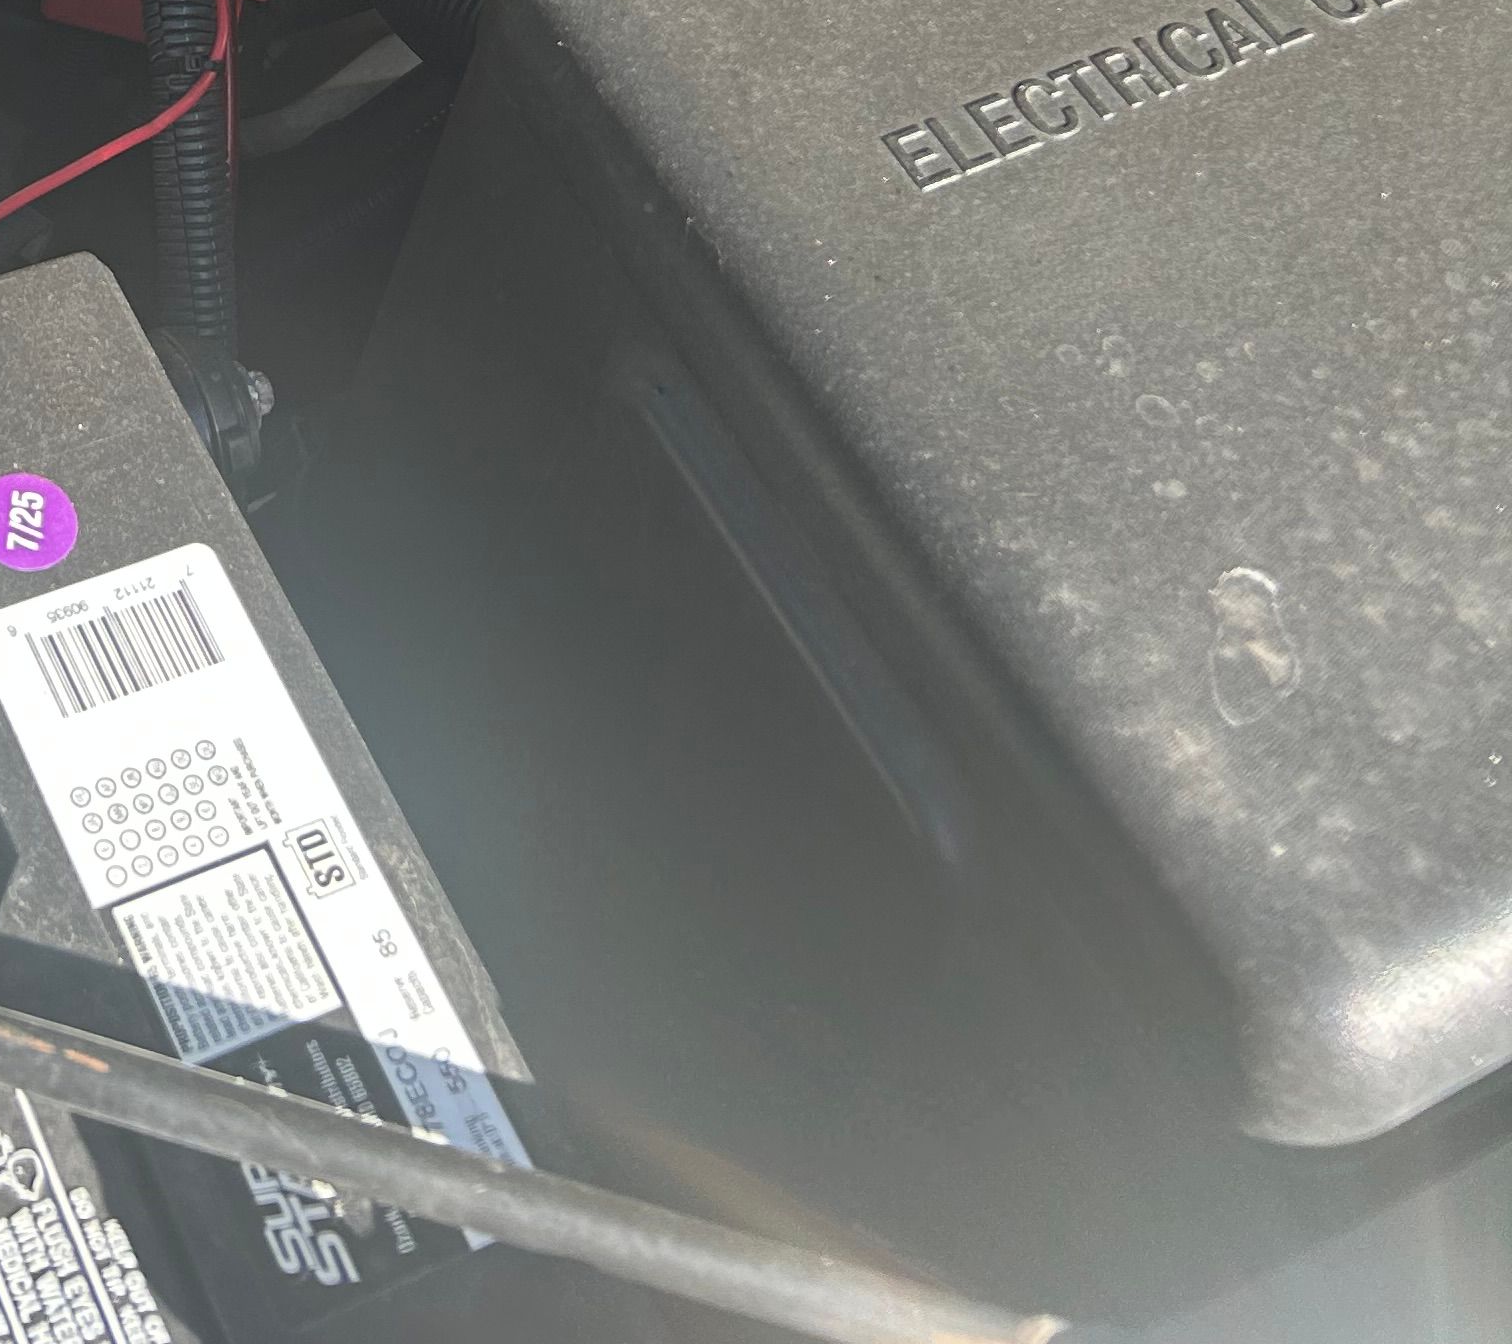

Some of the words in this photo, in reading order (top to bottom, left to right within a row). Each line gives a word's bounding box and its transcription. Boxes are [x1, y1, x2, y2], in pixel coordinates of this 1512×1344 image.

[5, 490, 46, 552] 7/25
[111, 574, 156, 602] 21112
[183, 563, 194, 576] 7
[5, 623, 18, 638] 6
[44, 597, 89, 625] 90935
[293, 823, 347, 891] STD
[369, 925, 400, 961] 85
[431, 1042, 470, 1097] 550
[11, 1207, 50, 1272] WITH
[32, 1198, 79, 1277] FLUSH
[64, 1276, 104, 1340] EYES
